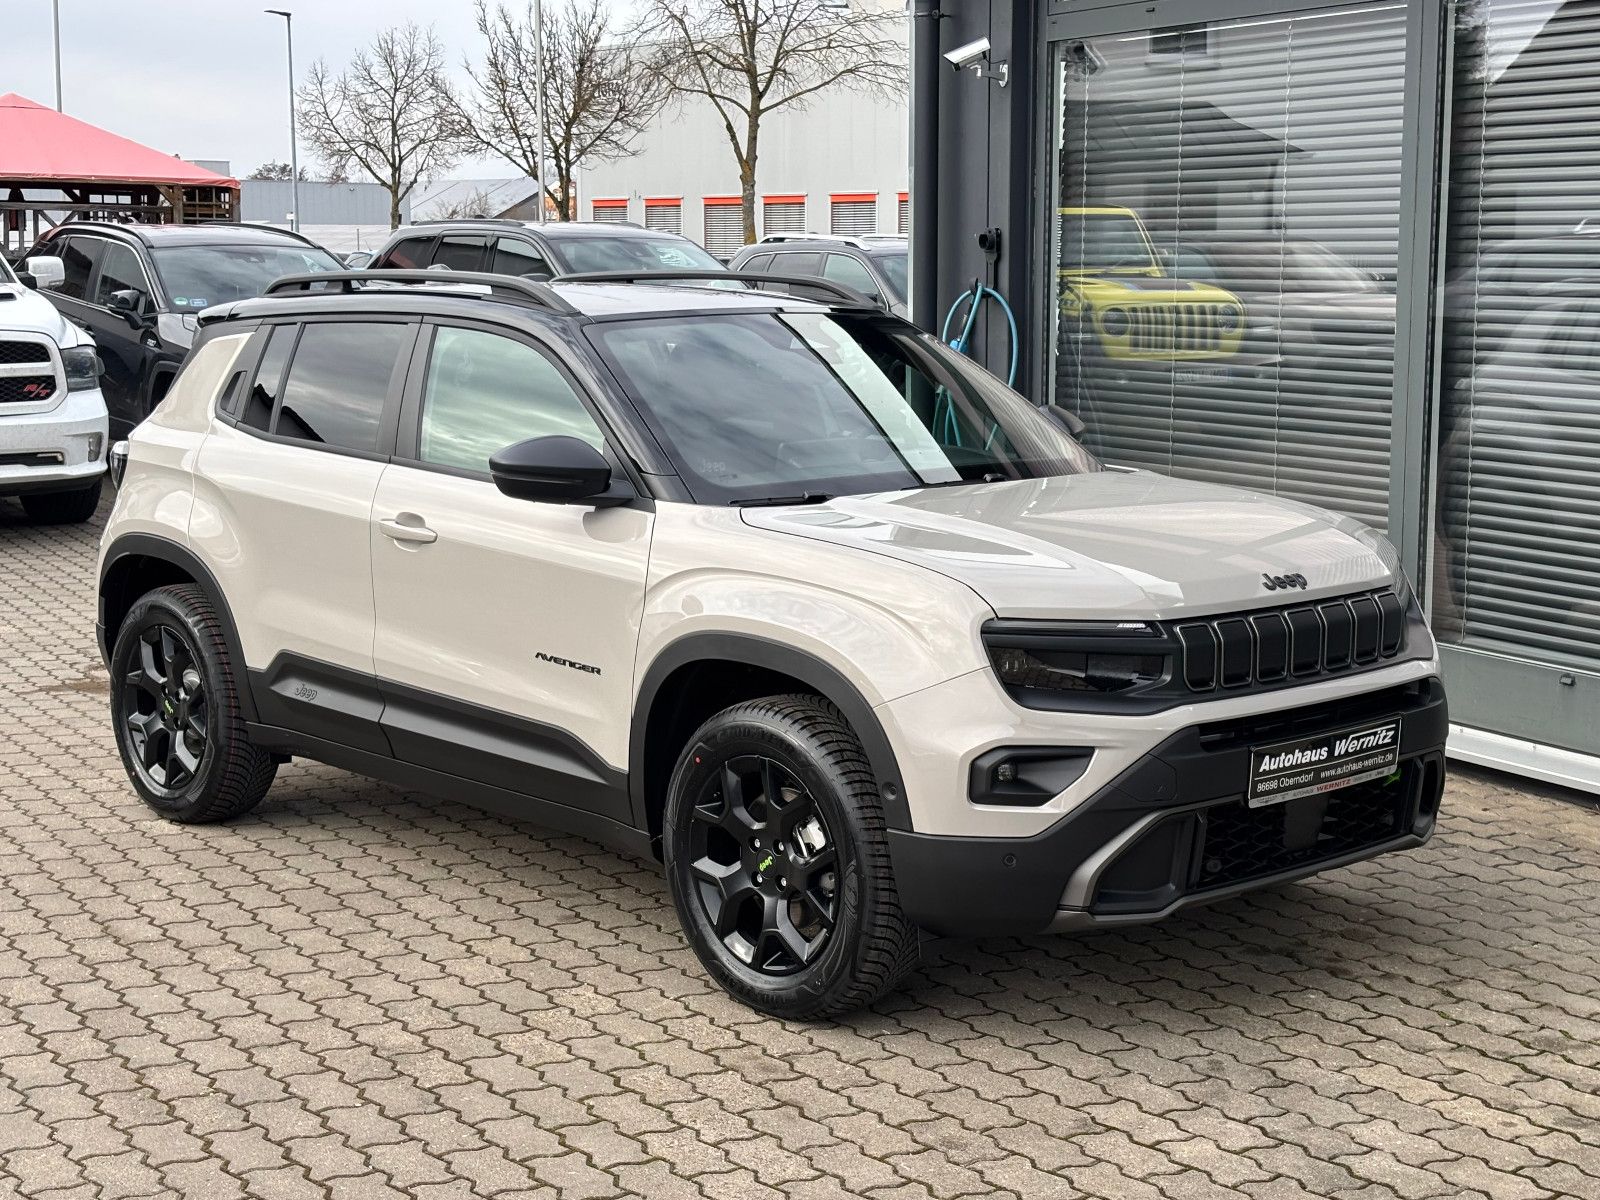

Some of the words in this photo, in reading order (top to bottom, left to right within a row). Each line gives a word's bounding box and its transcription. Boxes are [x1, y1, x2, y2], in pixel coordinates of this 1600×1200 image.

[23, 383, 51, 398] R/T
[1262, 572, 1308, 591] Jeep
[535, 652, 602, 676] AVENGER
[295, 683, 318, 702] Jeep
[1259, 746, 1329, 773] Autohaus
[1334, 727, 1395, 757] Wernitz
[1256, 779, 1278, 793] 86698
[1279, 771, 1315, 788] Oberndorf
[1320, 752, 1394, 779] www.autohaus-wernitz.de
[1316, 779, 1351, 792] WERNITZ
